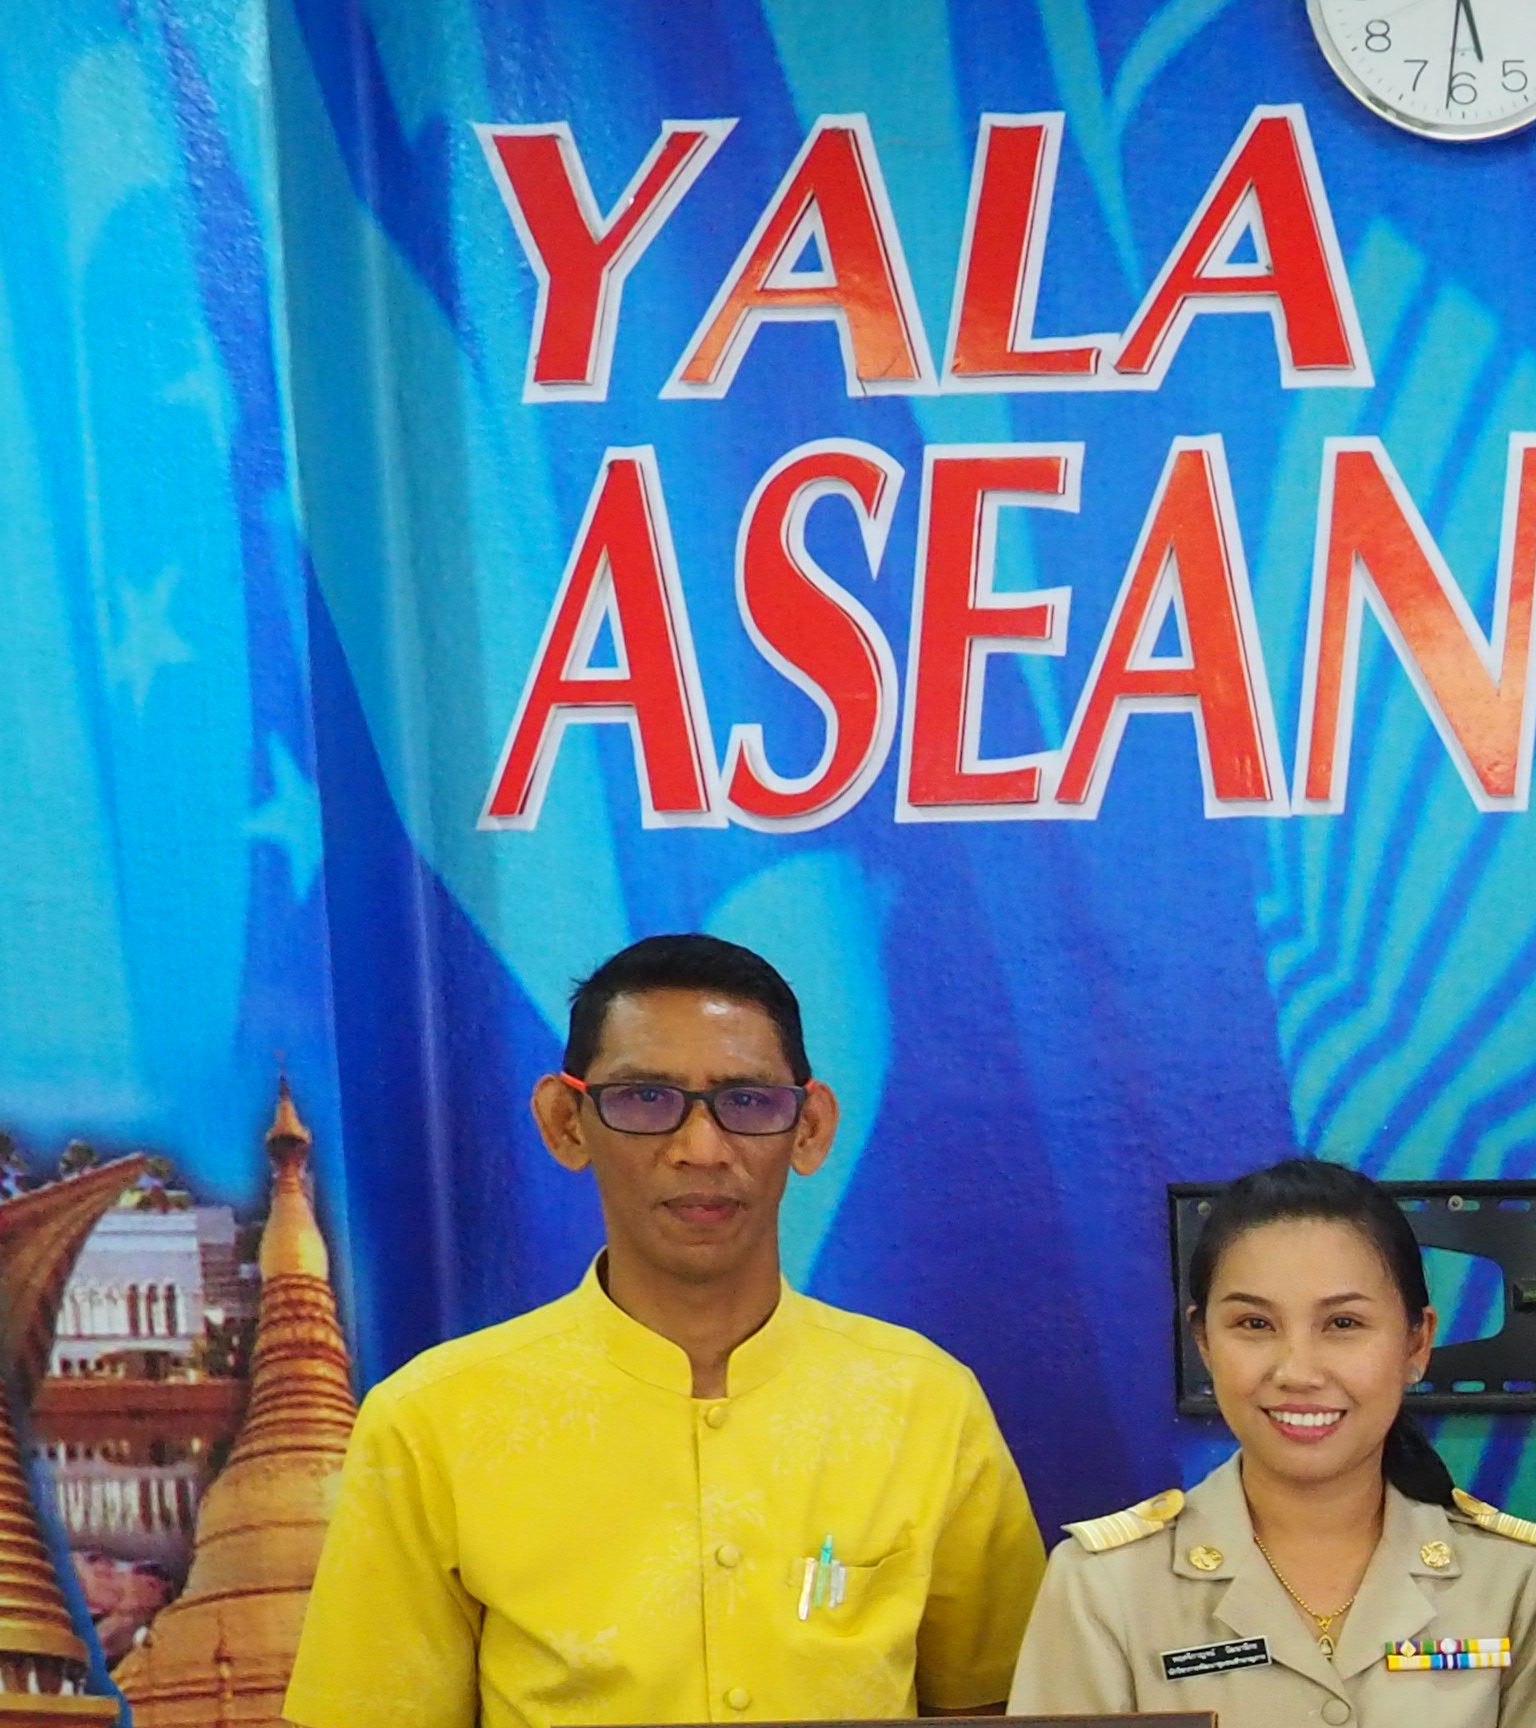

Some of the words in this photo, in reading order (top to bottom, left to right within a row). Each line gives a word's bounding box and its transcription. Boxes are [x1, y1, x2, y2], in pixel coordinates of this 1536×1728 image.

[1364, 19, 1392, 53] 8
[1403, 59, 1429, 92] 7
[1450, 71, 1478, 105] 6
[1501, 59, 1528, 93] 5
[488, 110, 1366, 392] YALA
